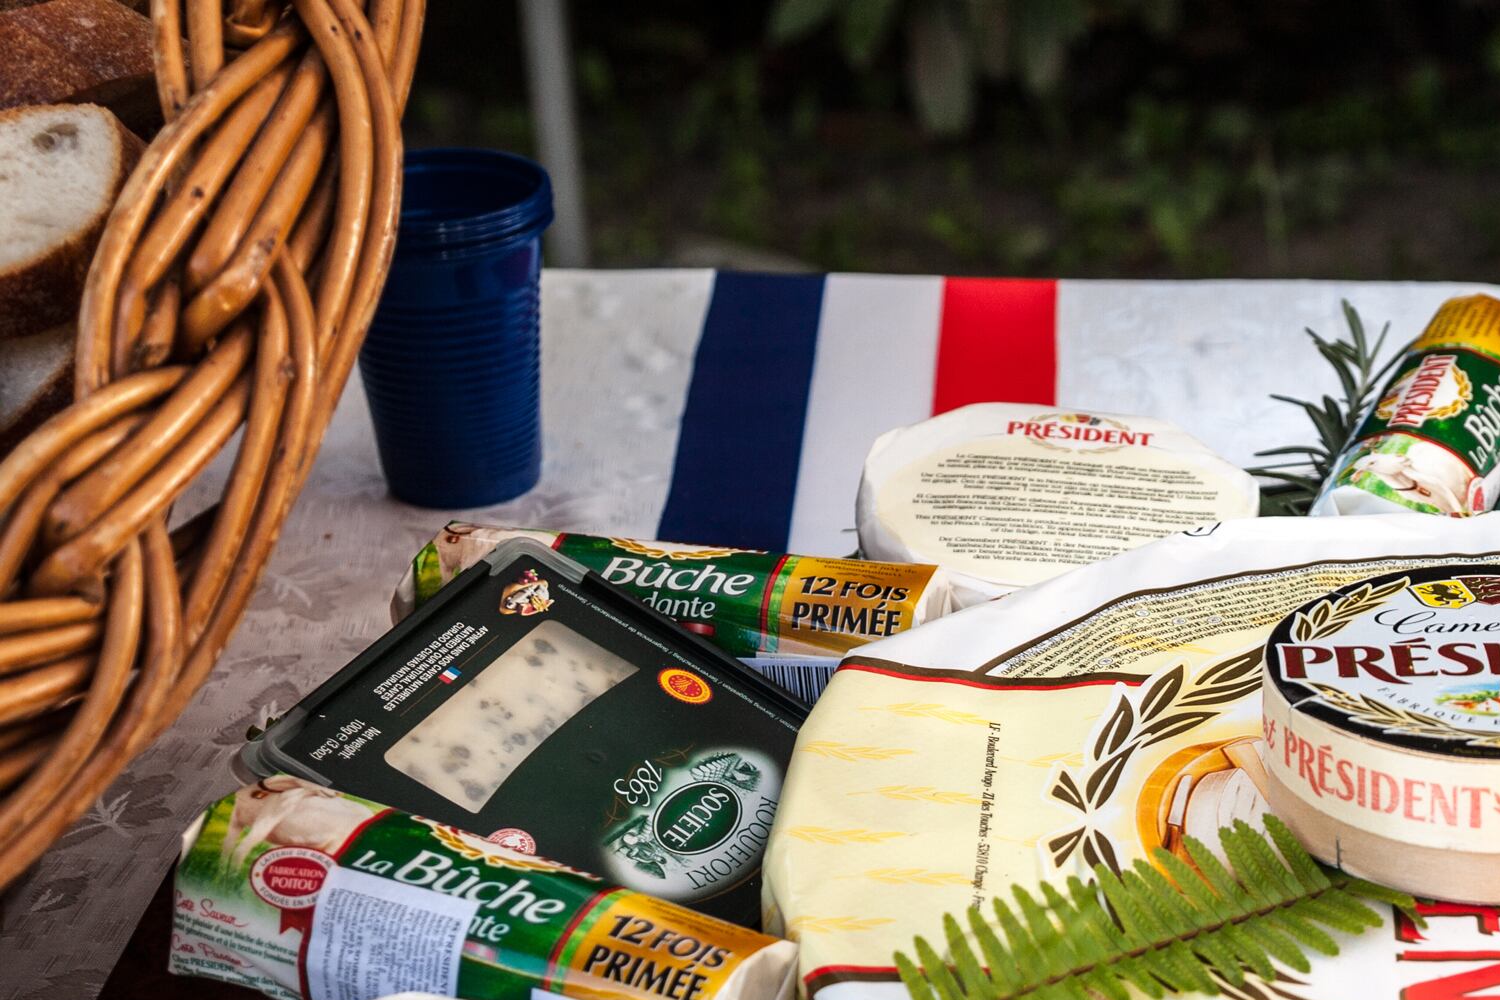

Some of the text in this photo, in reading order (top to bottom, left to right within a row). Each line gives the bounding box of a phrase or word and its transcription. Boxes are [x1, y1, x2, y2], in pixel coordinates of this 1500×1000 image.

[1388, 354, 1457, 428] PRÉSIDENT
[1006, 420, 1154, 448] PRÉSIDENT
[601, 557, 754, 596] Bûche
[800, 576, 910, 602] 12 FOIS
[791, 601, 902, 637] PRIMÉE
[438, 622, 465, 643] CURADO
[444, 626, 475, 650] MATURED
[468, 626, 488, 645] AFFINÉ
[407, 645, 433, 668] CUEVAS
[373, 663, 409, 695] NATURALES
[401, 661, 430, 685] NATURAL
[423, 663, 442, 682] CAVES
[381, 680, 404, 701] CAVES
[383, 677, 426, 711] NATURELLES
[340, 719, 365, 735] 100g
[367, 727, 382, 742] Net
[614, 760, 666, 808] 1863
[1284, 727, 1491, 829] PRÉSIDENT
[663, 787, 730, 847] SOCIÉTÉ
[981, 799, 994, 812] des
[979, 811, 993, 838] Touches
[687, 794, 778, 891] ROQUEFORT
[268, 865, 325, 878] FABRICATION
[271, 878, 318, 891] POITOU
[352, 849, 566, 924] La Bûche
[608, 914, 731, 969] 12 FOIS
